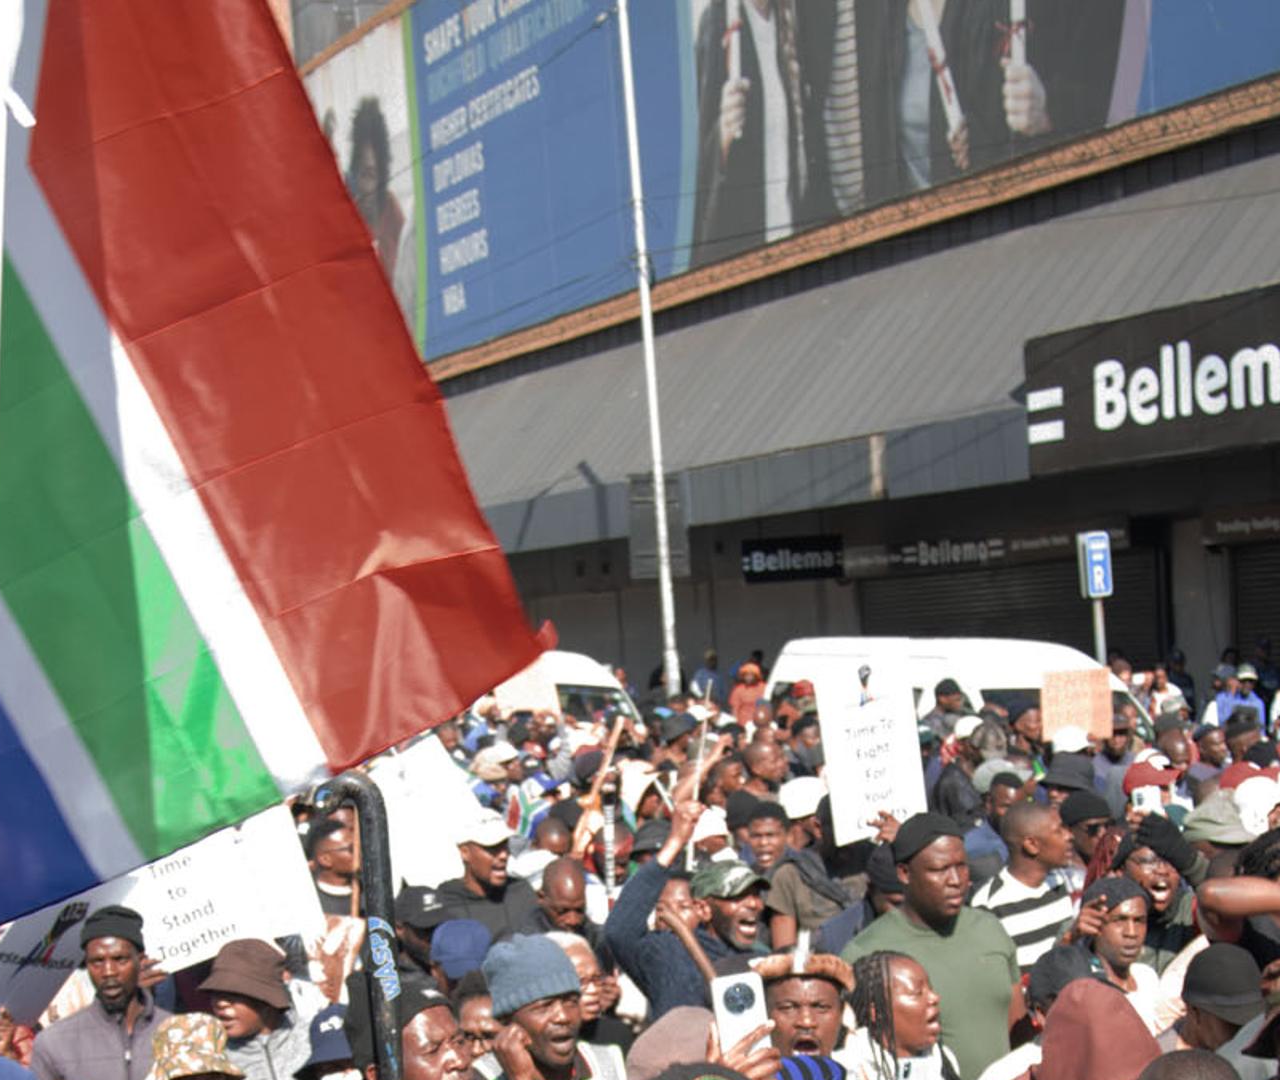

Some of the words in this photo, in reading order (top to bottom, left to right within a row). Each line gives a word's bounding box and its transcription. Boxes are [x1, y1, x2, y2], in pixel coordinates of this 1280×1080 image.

[436, 188, 481, 234] DEGREES
[439, 228, 488, 276] HONOURS
[753, 549, 833, 573] Bellema
[919, 540, 989, 567] Bellema
[148, 856, 192, 879] Time
[167, 886, 187, 900] to
[162, 898, 215, 931] Stand
[158, 923, 237, 961] Together
